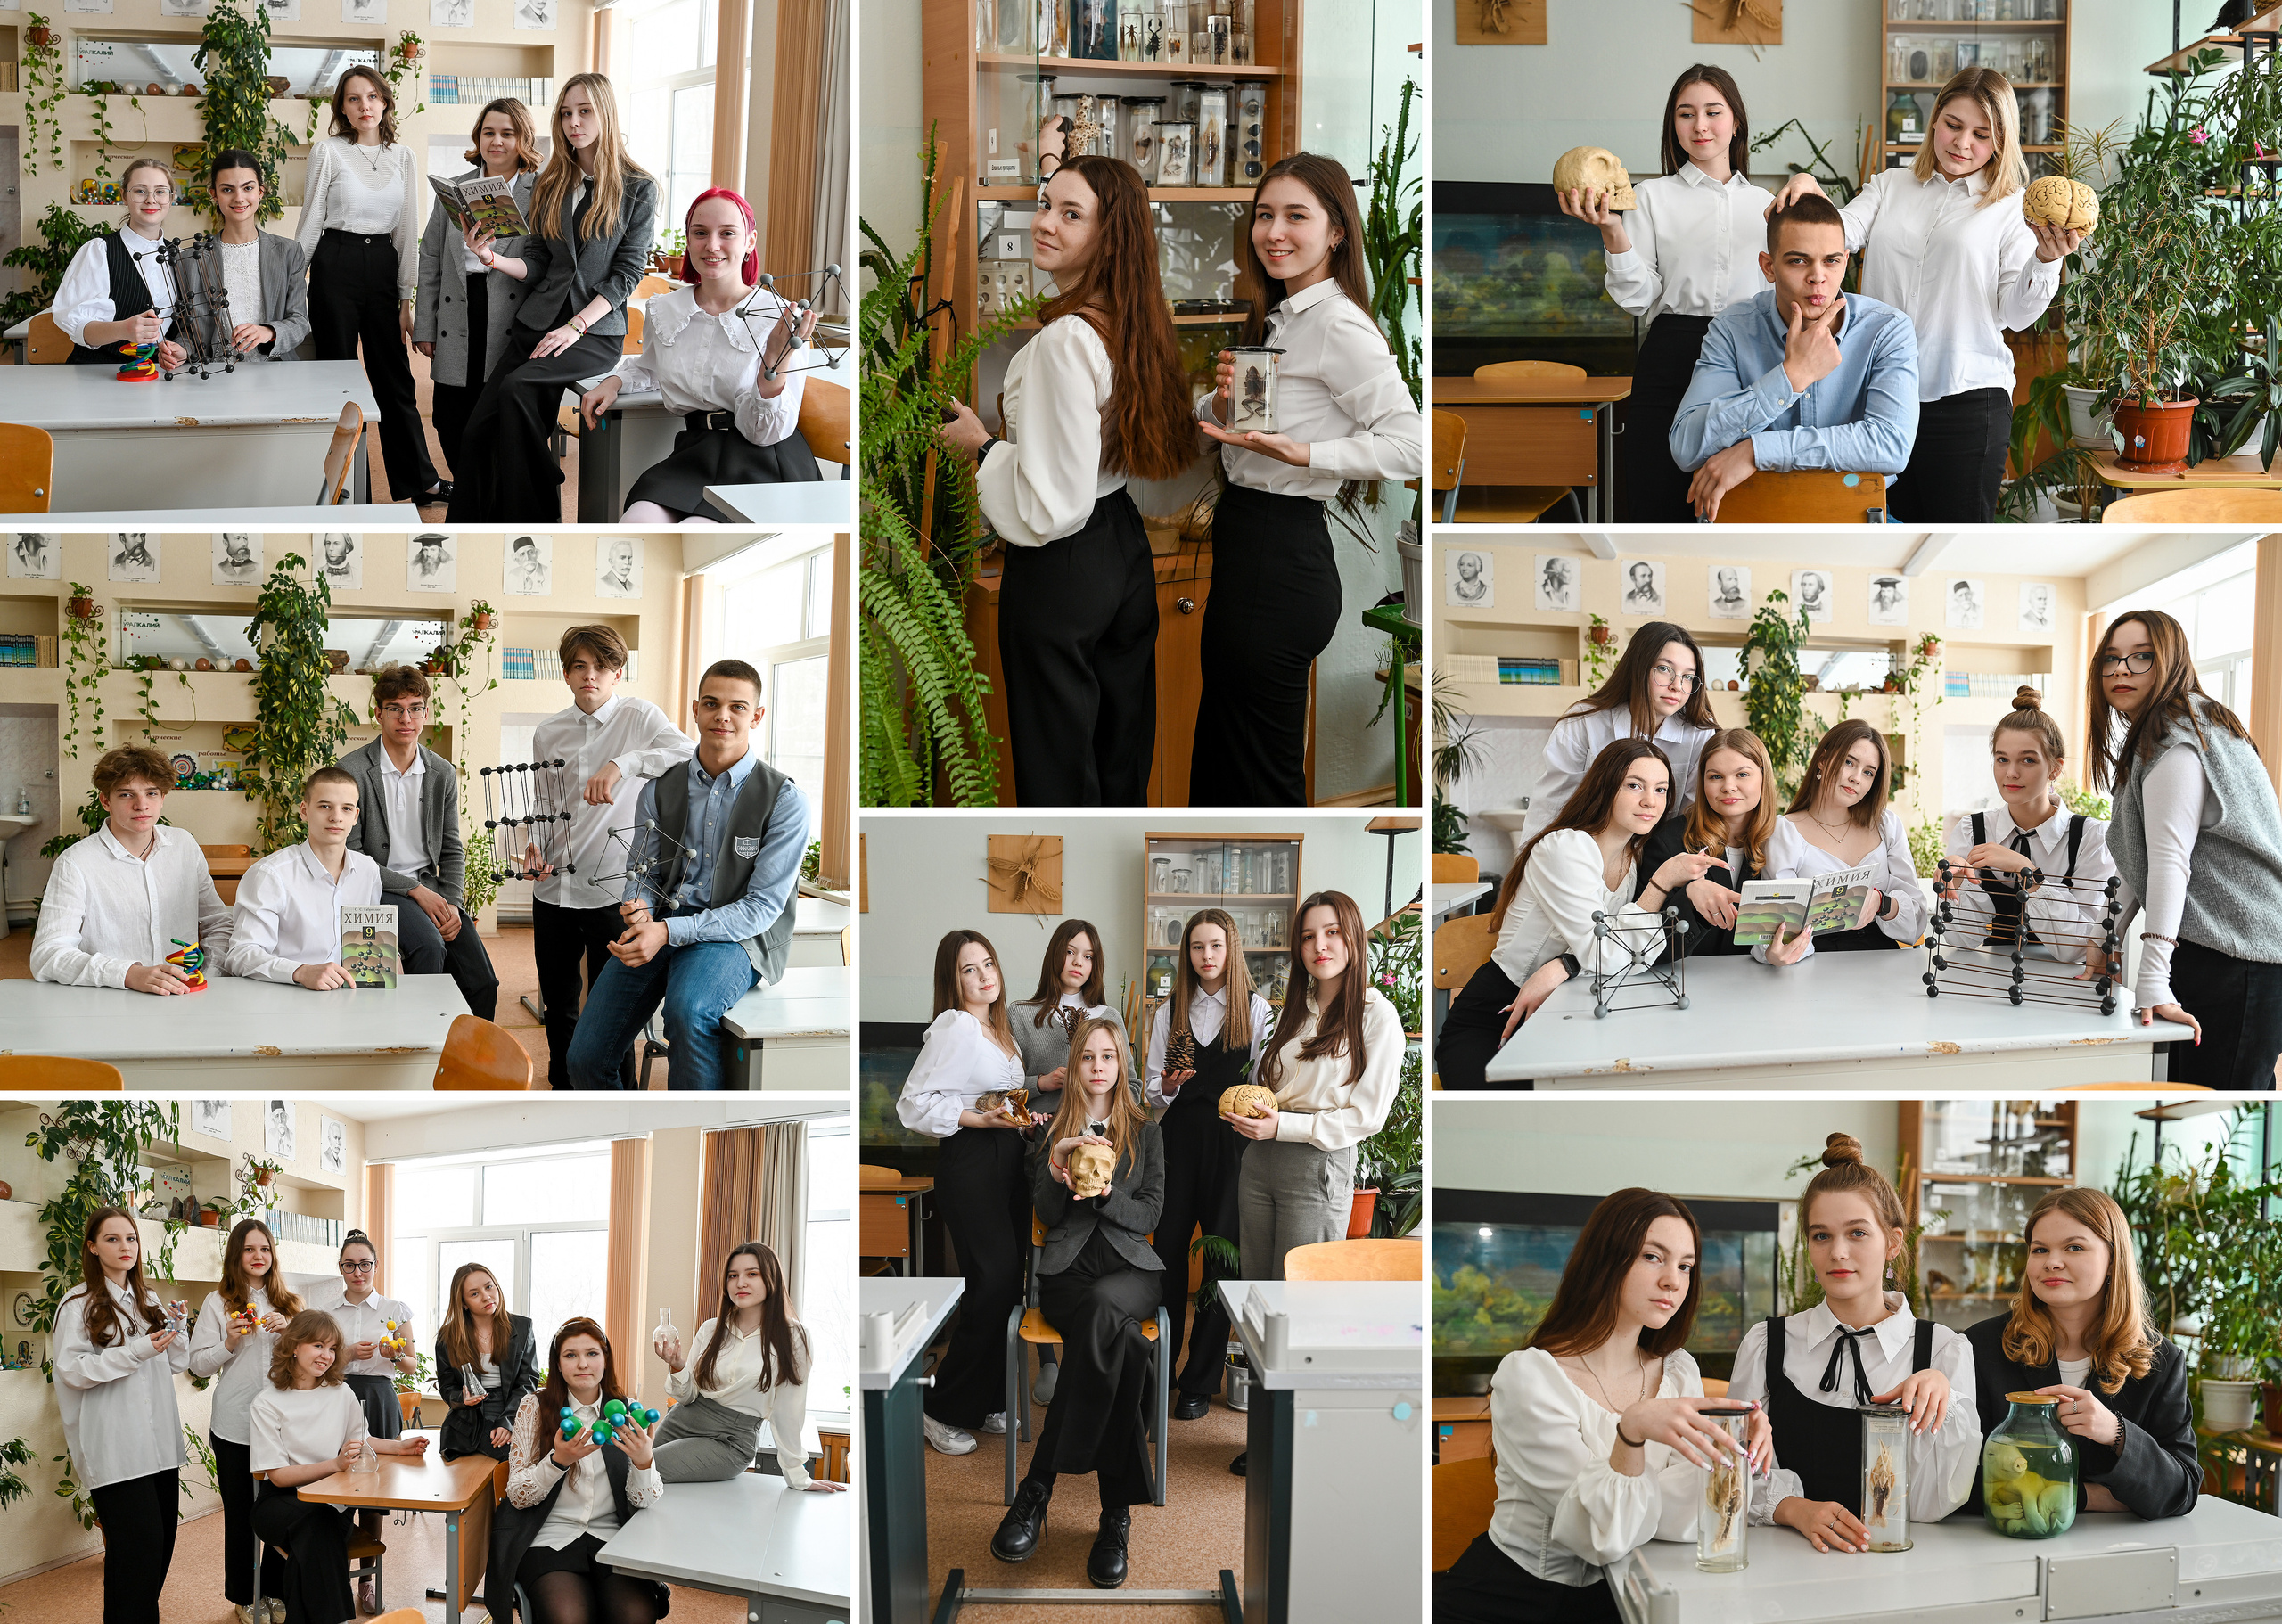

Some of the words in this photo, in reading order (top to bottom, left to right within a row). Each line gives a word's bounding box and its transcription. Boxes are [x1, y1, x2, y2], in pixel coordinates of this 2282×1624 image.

[462, 181, 505, 197] ХИМИЯ
[484, 194, 493, 203] 9
[1006, 242, 1014, 252] 8
[1814, 869, 1871, 890] ХИМИЯ
[1835, 886, 1844, 895] 9
[344, 913, 394, 923] ХИМИЯ
[365, 927, 373, 937] 9
